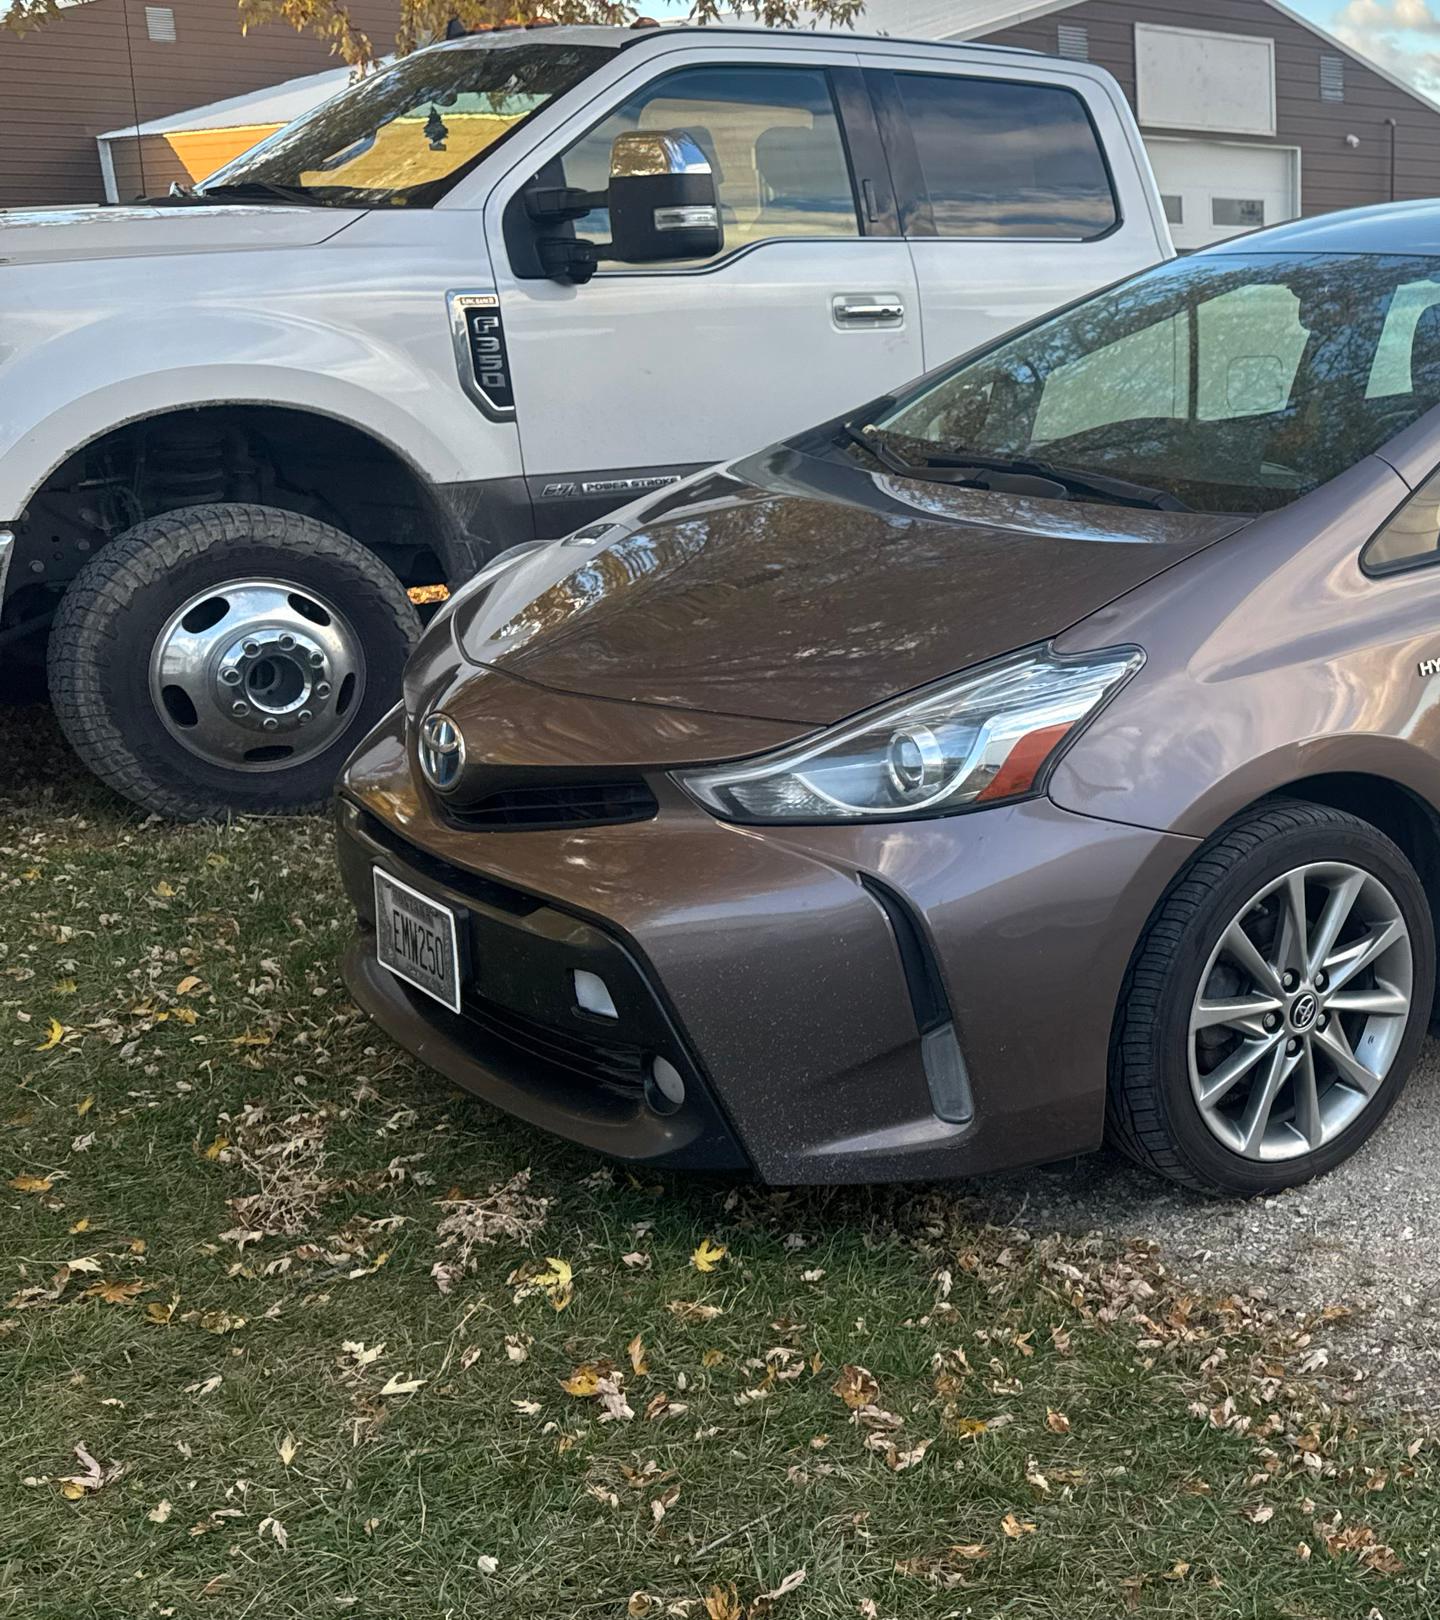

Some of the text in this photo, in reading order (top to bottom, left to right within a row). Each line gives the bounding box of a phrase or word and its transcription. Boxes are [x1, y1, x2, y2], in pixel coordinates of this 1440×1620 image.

[473, 316, 506, 388] F350
[586, 480, 629, 492] POWER
[393, 909, 445, 981] EMW250
